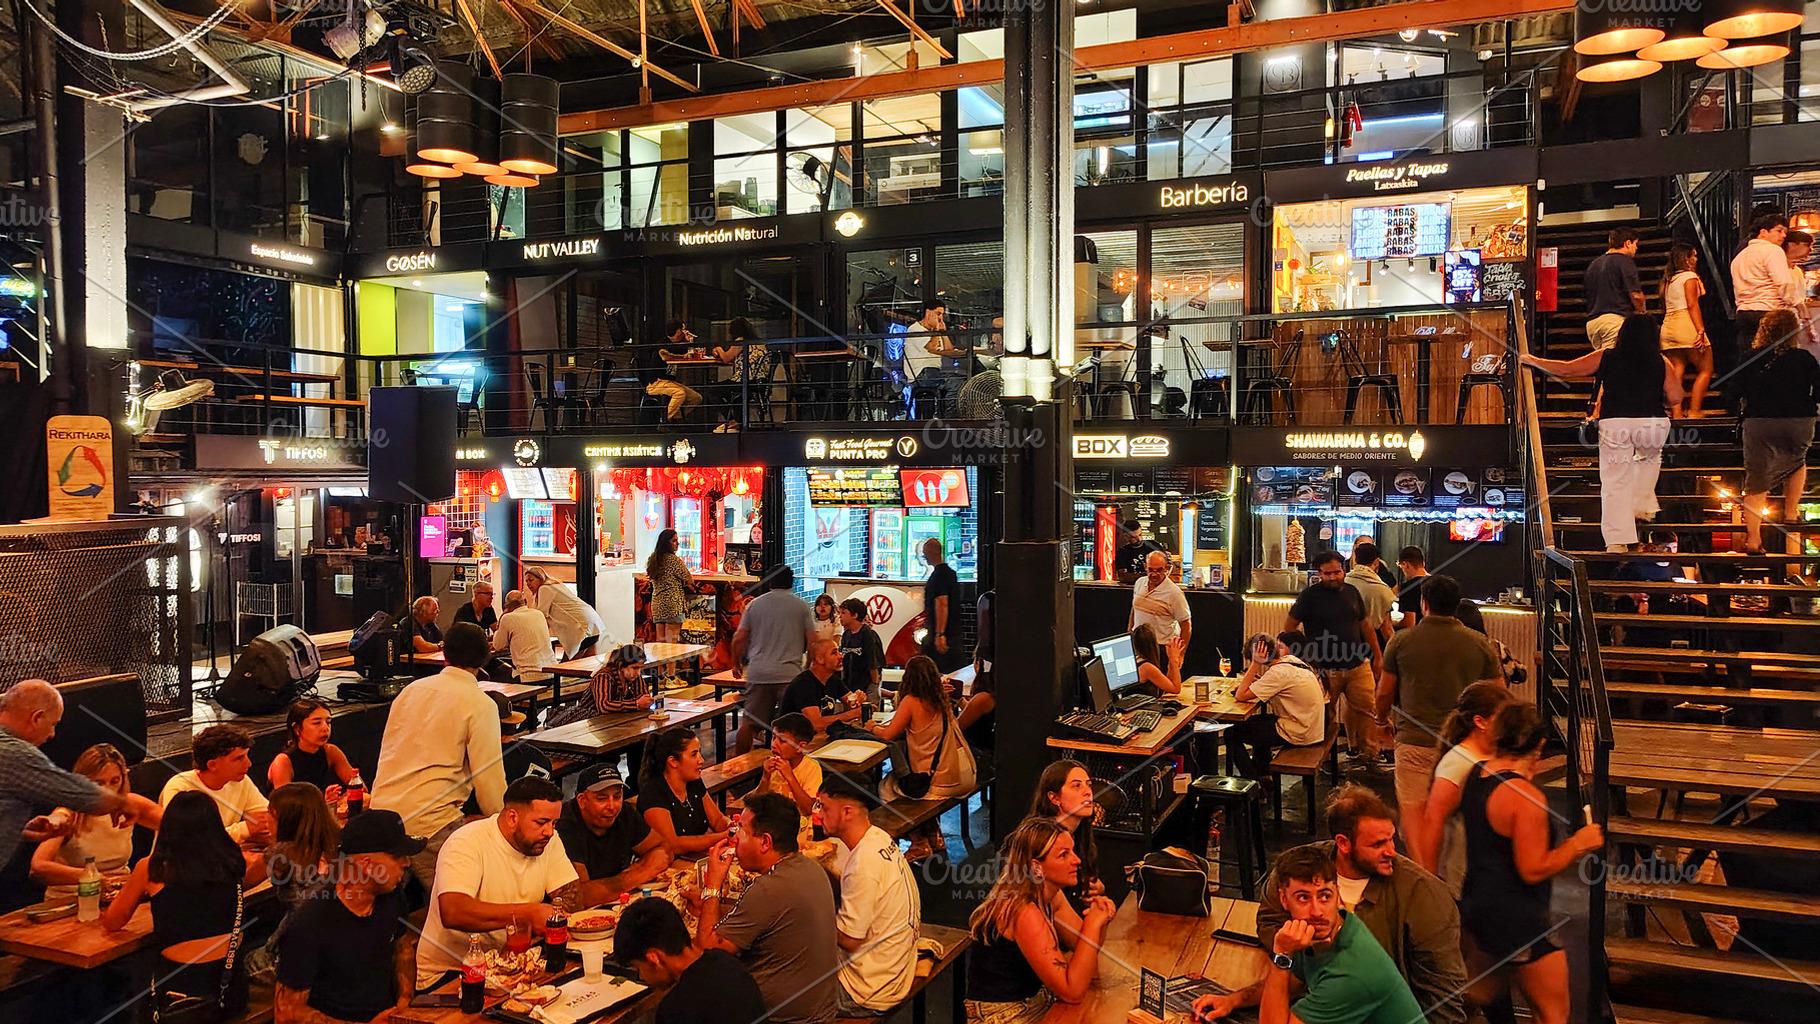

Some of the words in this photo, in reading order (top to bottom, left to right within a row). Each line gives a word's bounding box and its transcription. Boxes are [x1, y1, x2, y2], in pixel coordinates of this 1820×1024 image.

[1346, 166, 1394, 182] Paellas
[1394, 166, 1405, 181] y
[1407, 162, 1448, 178] Tapas
[1160, 181, 1249, 208] Barbería
[1387, 208, 1415, 217] RABAS
[1387, 218, 1415, 227] RABAS
[679, 228, 732, 247] Nutrición
[734, 225, 778, 242] Natural
[1386, 227, 1415, 236] RABAS
[1386, 237, 1414, 246] RABAS
[251, 244, 280, 259] Espacio
[280, 250, 314, 265] Saludable
[523, 244, 550, 260] NUT
[551, 240, 599, 256] VALLEY
[1386, 246, 1414, 255] RABAS
[909, 253, 918, 262] 3
[1451, 279, 1474, 288] OFF
[829, 440, 846, 450] Fast
[846, 438, 863, 449] Food
[864, 438, 894, 449] Gourmet
[1077, 439, 1122, 455] BOX
[1285, 434, 1367, 449] SHAWARMA
[1368, 434, 1381, 448] &
[1383, 434, 1408, 448] CO.
[284, 446, 328, 460] TIFFOSI
[585, 446, 621, 457] CANTINA
[829, 450, 863, 460] PUNTA
[865, 450, 887, 460] PRO
[1339, 452, 1363, 460] MEDIO
[1364, 452, 1397, 460] ORIENTE
[230, 532, 261, 543] TIFFOSI
